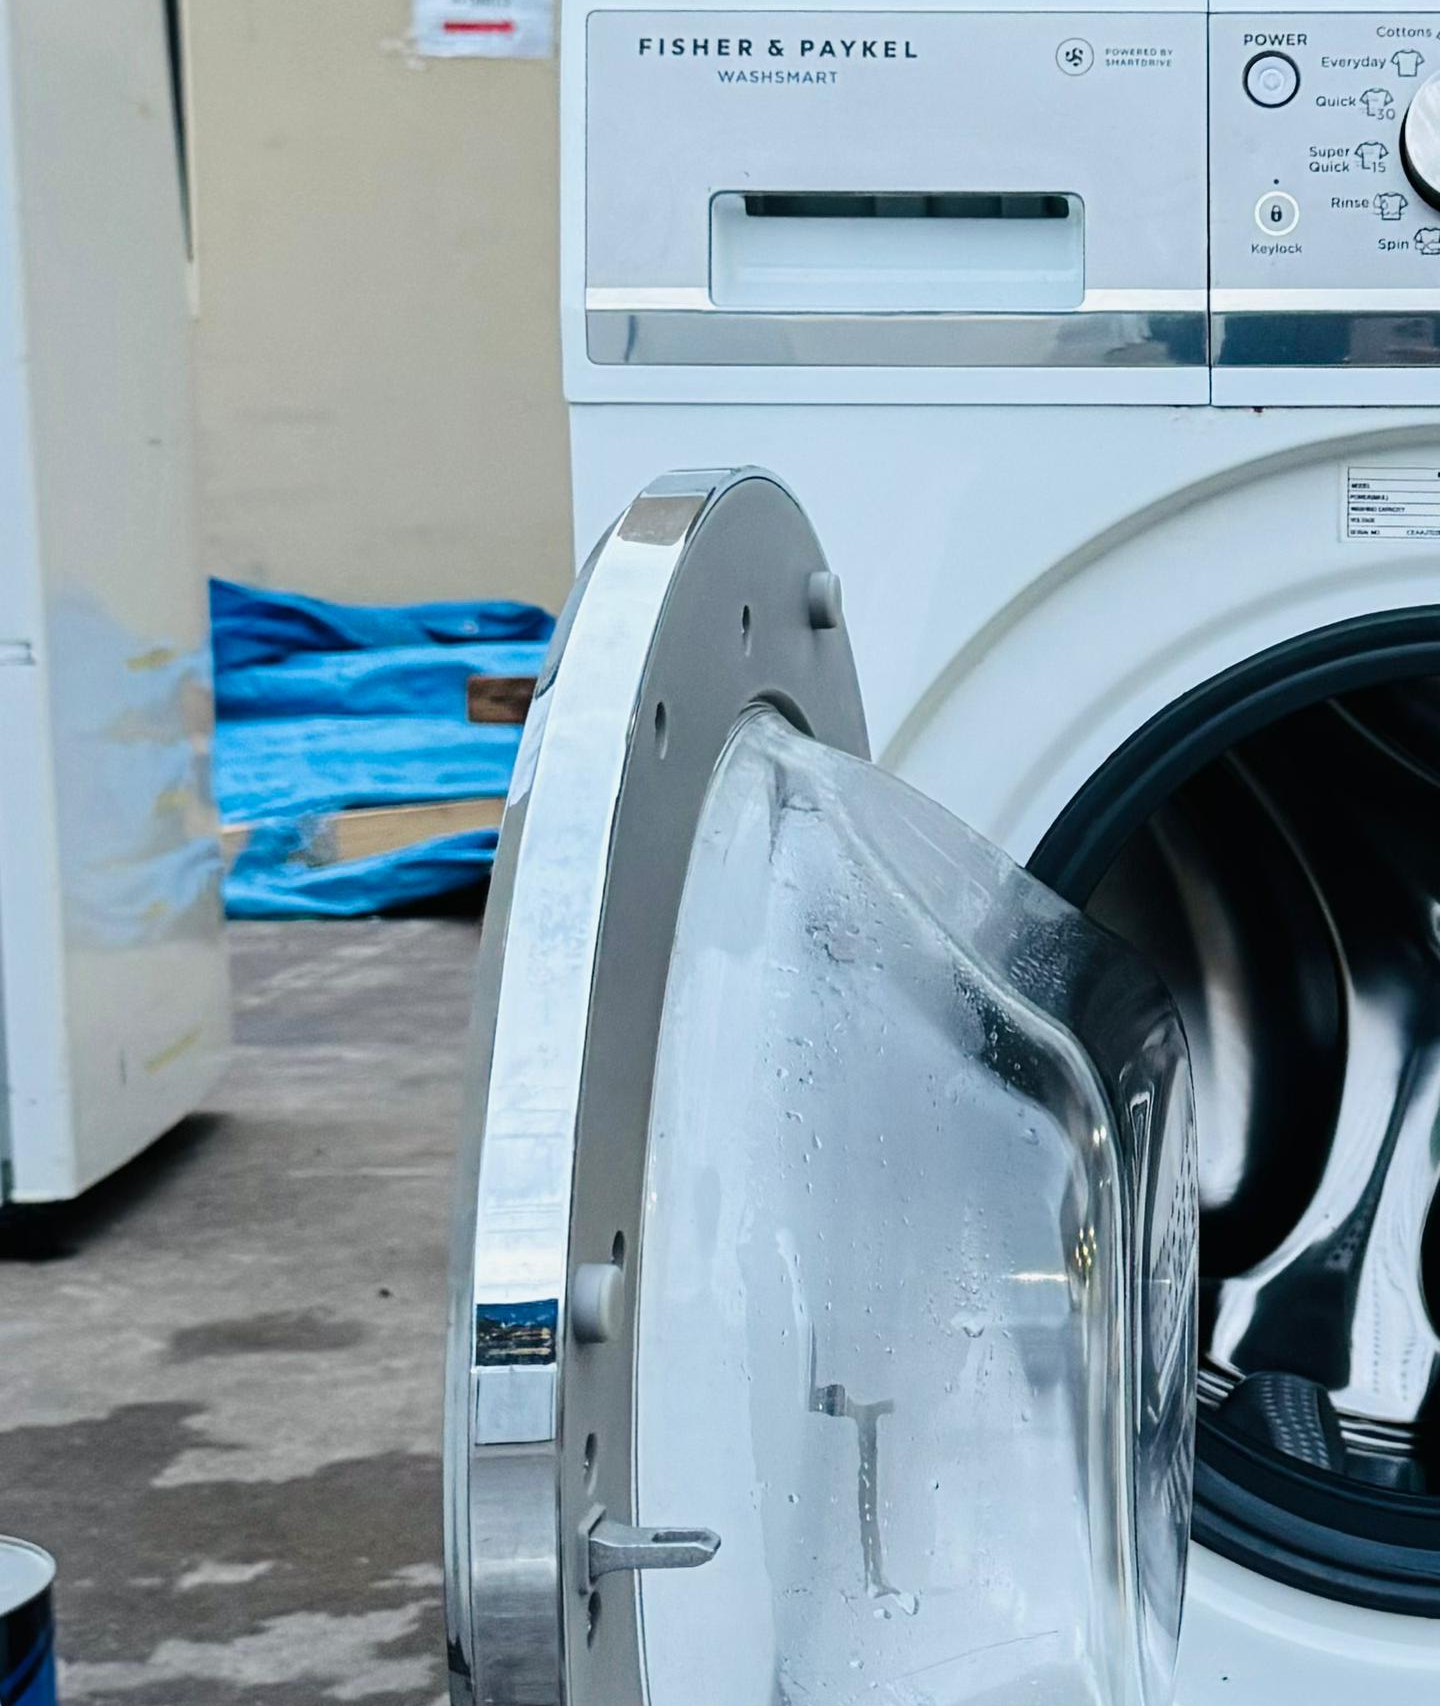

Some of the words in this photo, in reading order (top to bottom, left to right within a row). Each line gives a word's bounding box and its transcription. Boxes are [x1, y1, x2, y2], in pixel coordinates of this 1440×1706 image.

[1376, 26, 1432, 39] Cottons
[1243, 33, 1308, 47] POWER
[639, 38, 754, 58] FISHER
[768, 38, 785, 58] &
[801, 39, 918, 59] PAYKEL
[1321, 56, 1387, 70] Everyday
[718, 70, 838, 85] WASHSMART
[1315, 95, 1357, 109] Quick
[1377, 107, 1396, 120] 30
[1309, 146, 1350, 160] Super
[1308, 160, 1350, 174] Quick
[1371, 160, 1386, 173] 15
[1331, 196, 1369, 209] Rinse
[1251, 242, 1303, 255] Keylock
[1378, 237, 1409, 252] Spin
